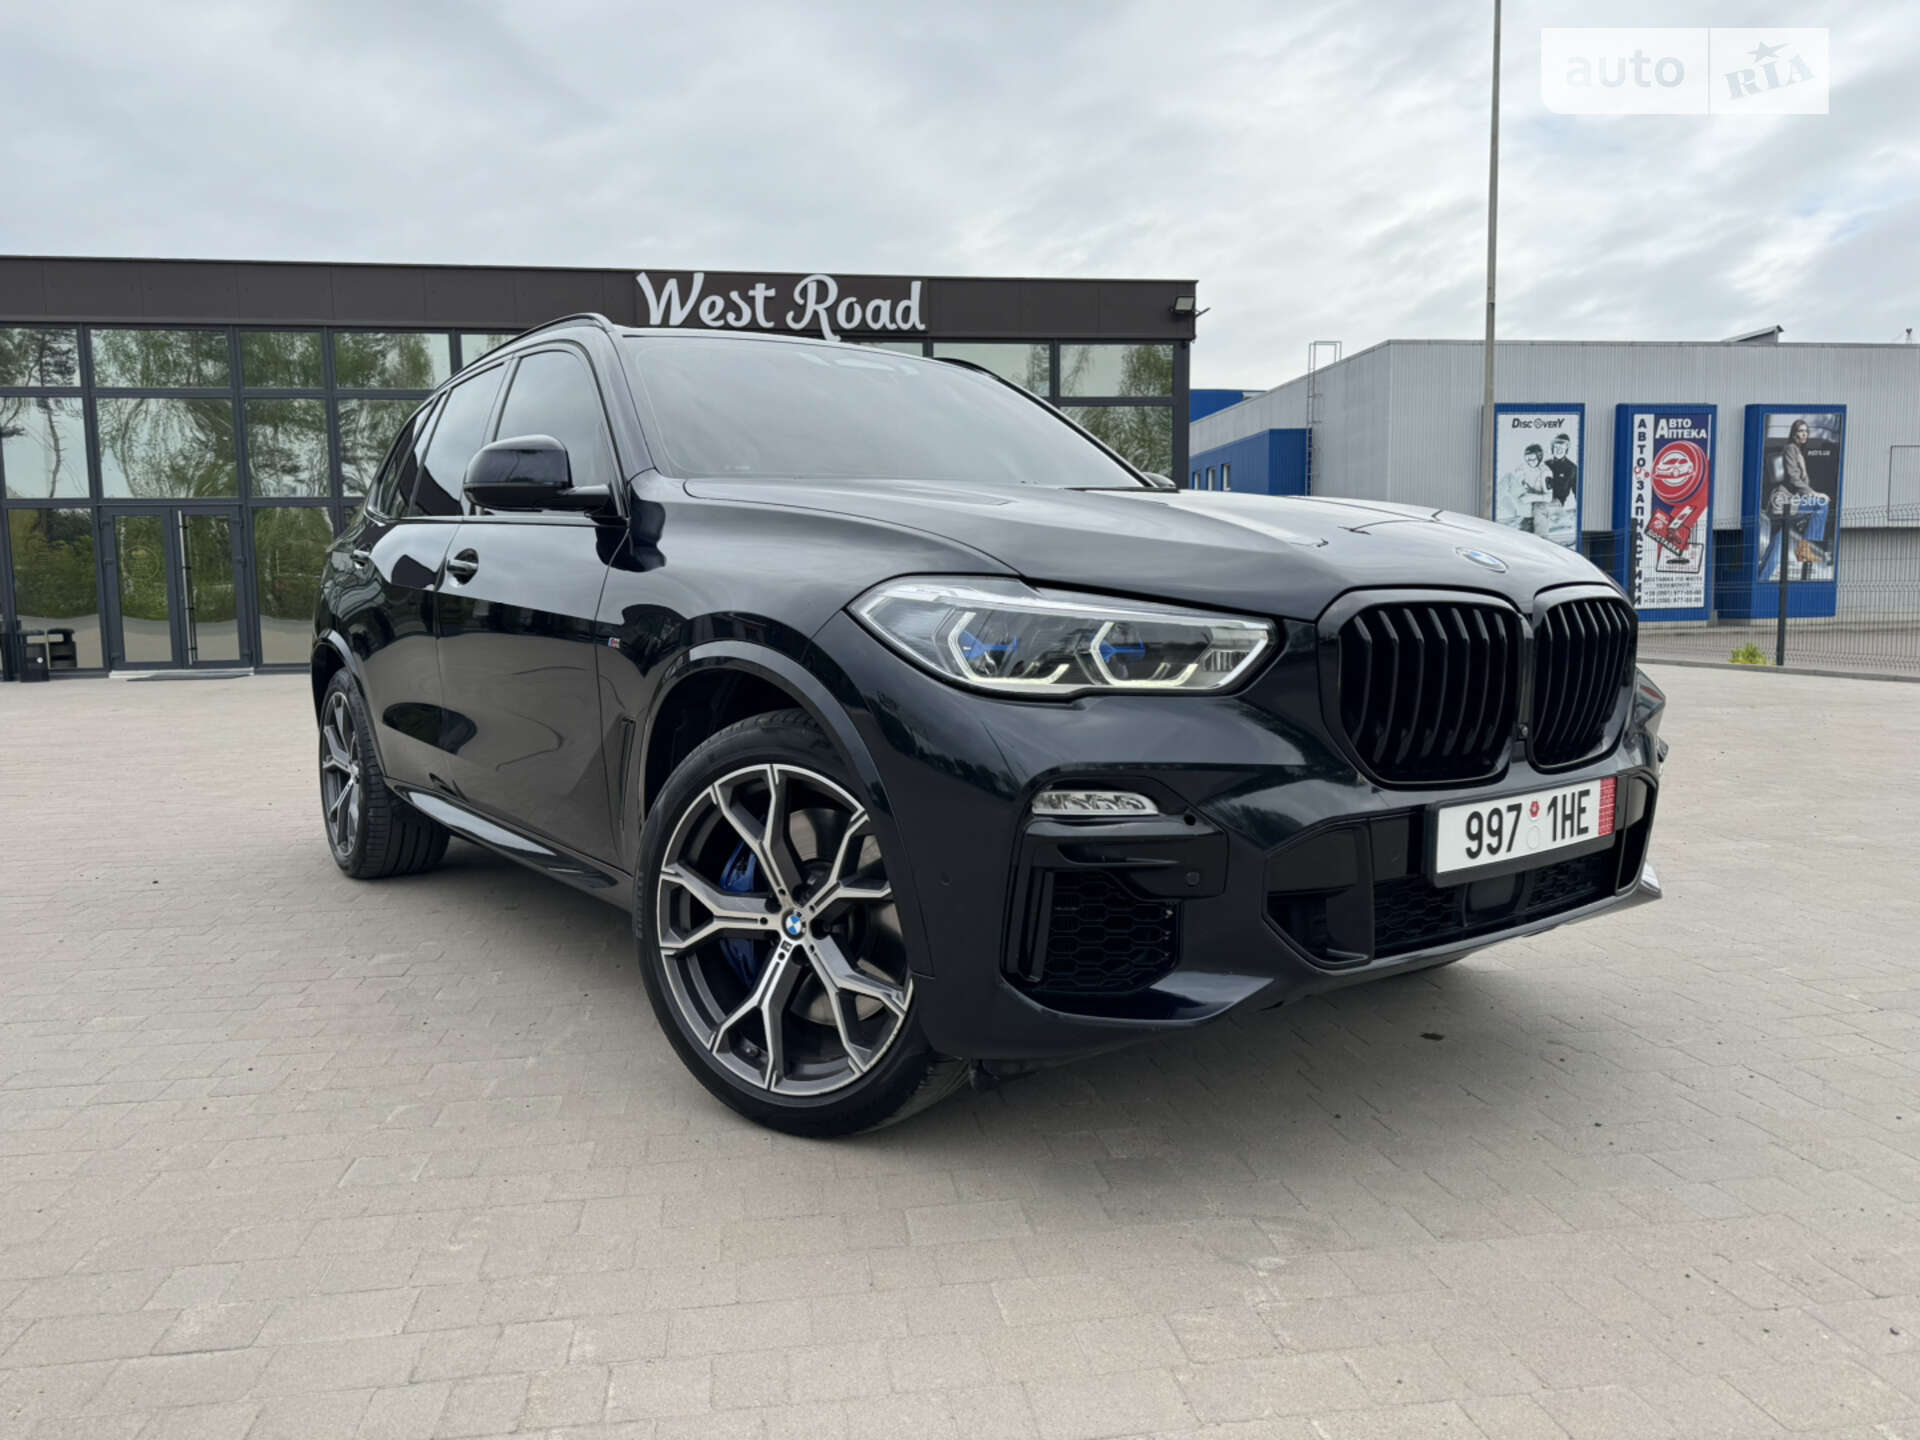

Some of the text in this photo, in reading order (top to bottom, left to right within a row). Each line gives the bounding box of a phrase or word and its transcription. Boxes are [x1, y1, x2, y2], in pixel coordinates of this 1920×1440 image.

[635, 271, 927, 342] West Road
[1465, 803, 1522, 860] 997
[1546, 788, 1591, 842] 1HE
